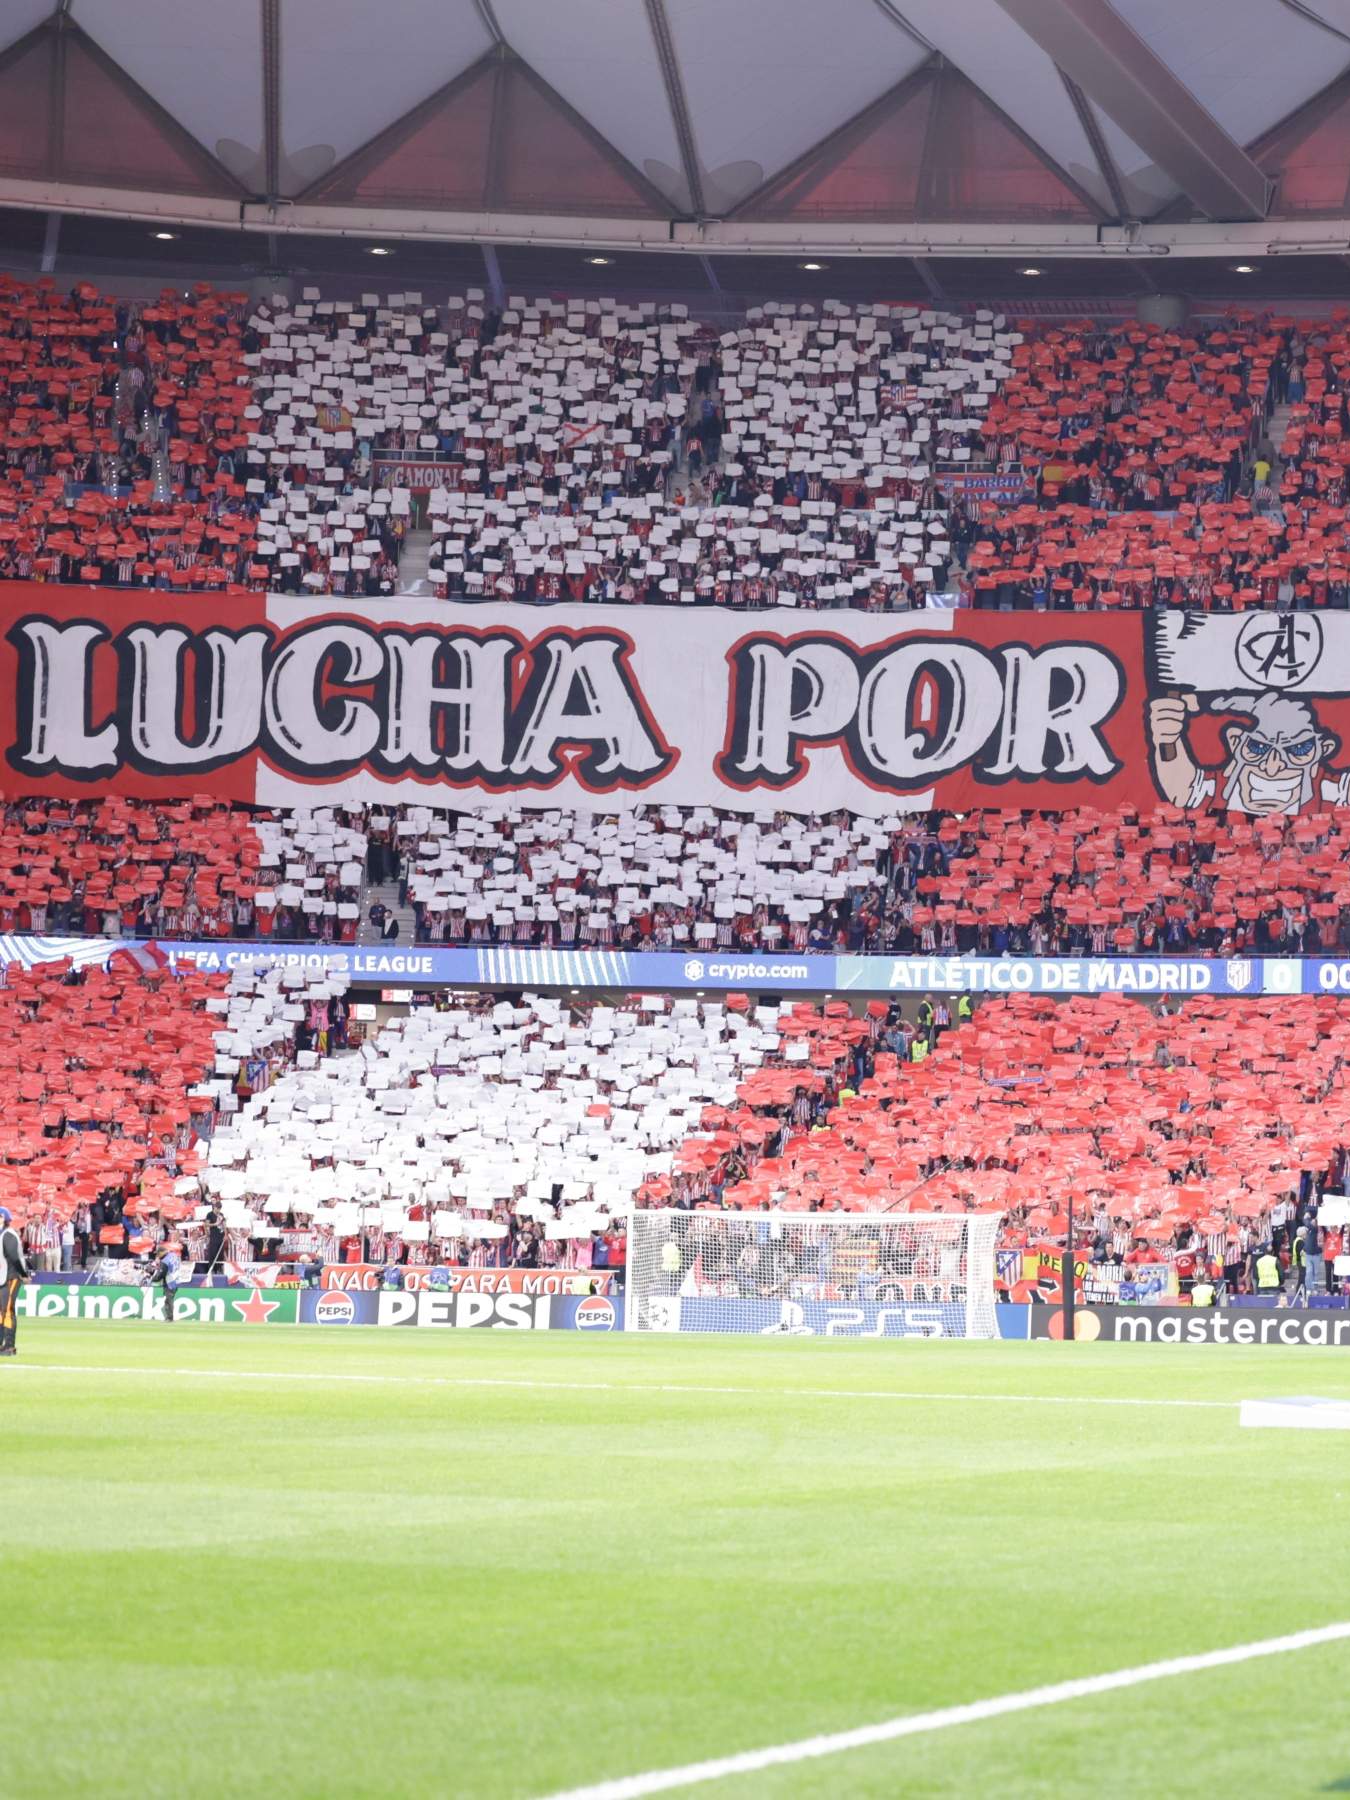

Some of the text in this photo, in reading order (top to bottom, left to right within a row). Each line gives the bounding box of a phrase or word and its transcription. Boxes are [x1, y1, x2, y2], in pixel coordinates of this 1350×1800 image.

[394, 466, 459, 489] GAMONAL
[10, 614, 1126, 788] LUCHA POR
[354, 956, 433, 973] LEAGUE
[708, 963, 808, 980] crypto.com
[889, 956, 1211, 990] ATLÉTICO DE MADRID
[521, 1273, 606, 1295] MORR
[15, 1284, 226, 1320] Heineken
[317, 1306, 351, 1317] PEPSI
[378, 1290, 552, 1330] PEPSI
[577, 1311, 613, 1322] PEPSI
